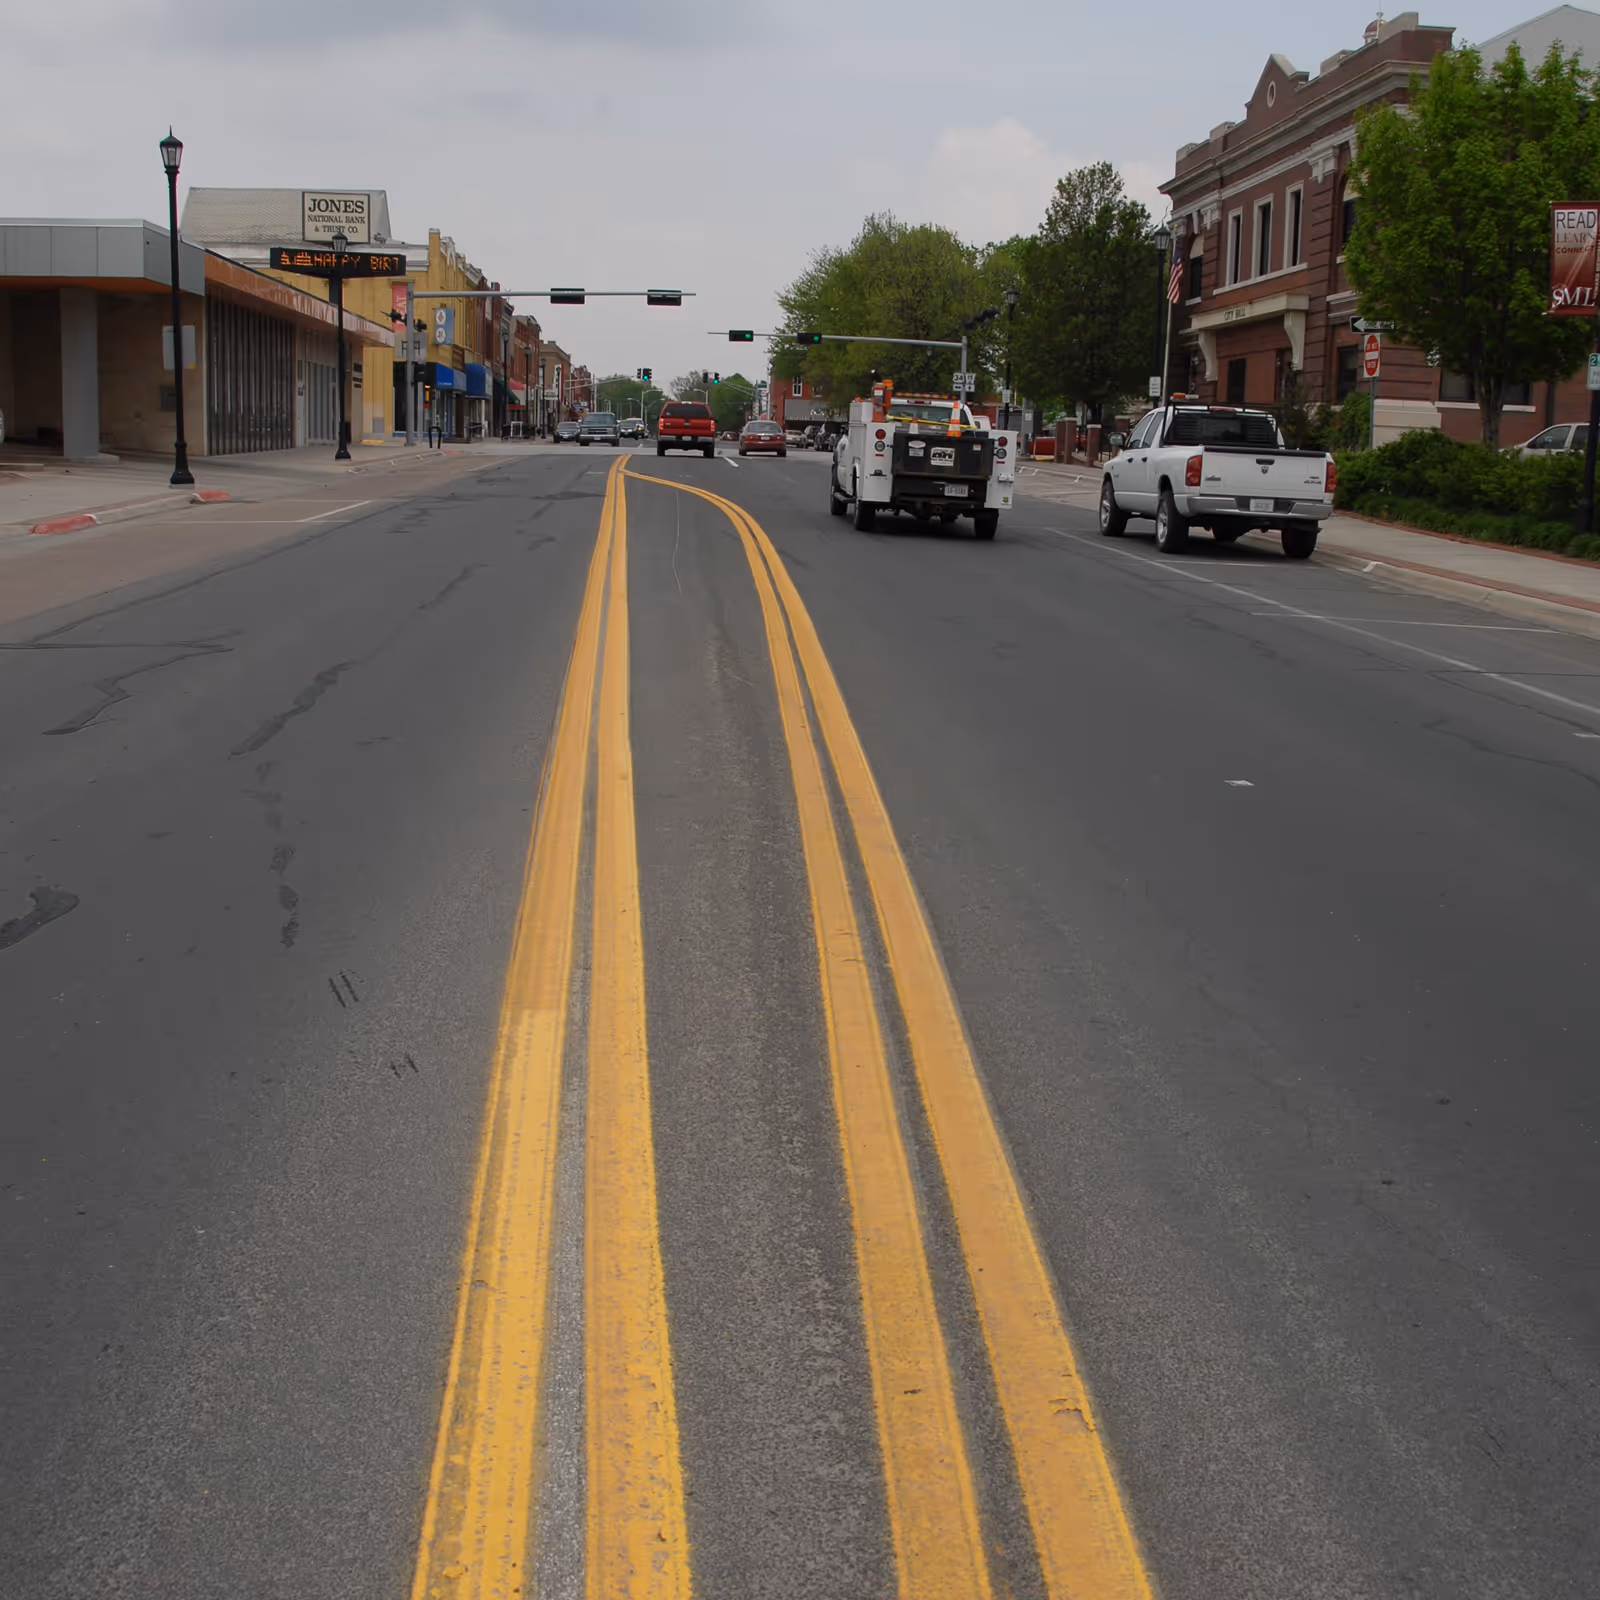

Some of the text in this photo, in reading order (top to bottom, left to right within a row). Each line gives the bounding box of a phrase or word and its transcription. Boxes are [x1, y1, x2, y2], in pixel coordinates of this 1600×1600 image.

[308, 198, 365, 214] JONES
[307, 215, 366, 224] NATIONAL BANK
[1556, 211, 1596, 229] READ
[314, 225, 320, 233] &
[322, 225, 346, 234] TRUST
[1552, 286, 1596, 309] SML
